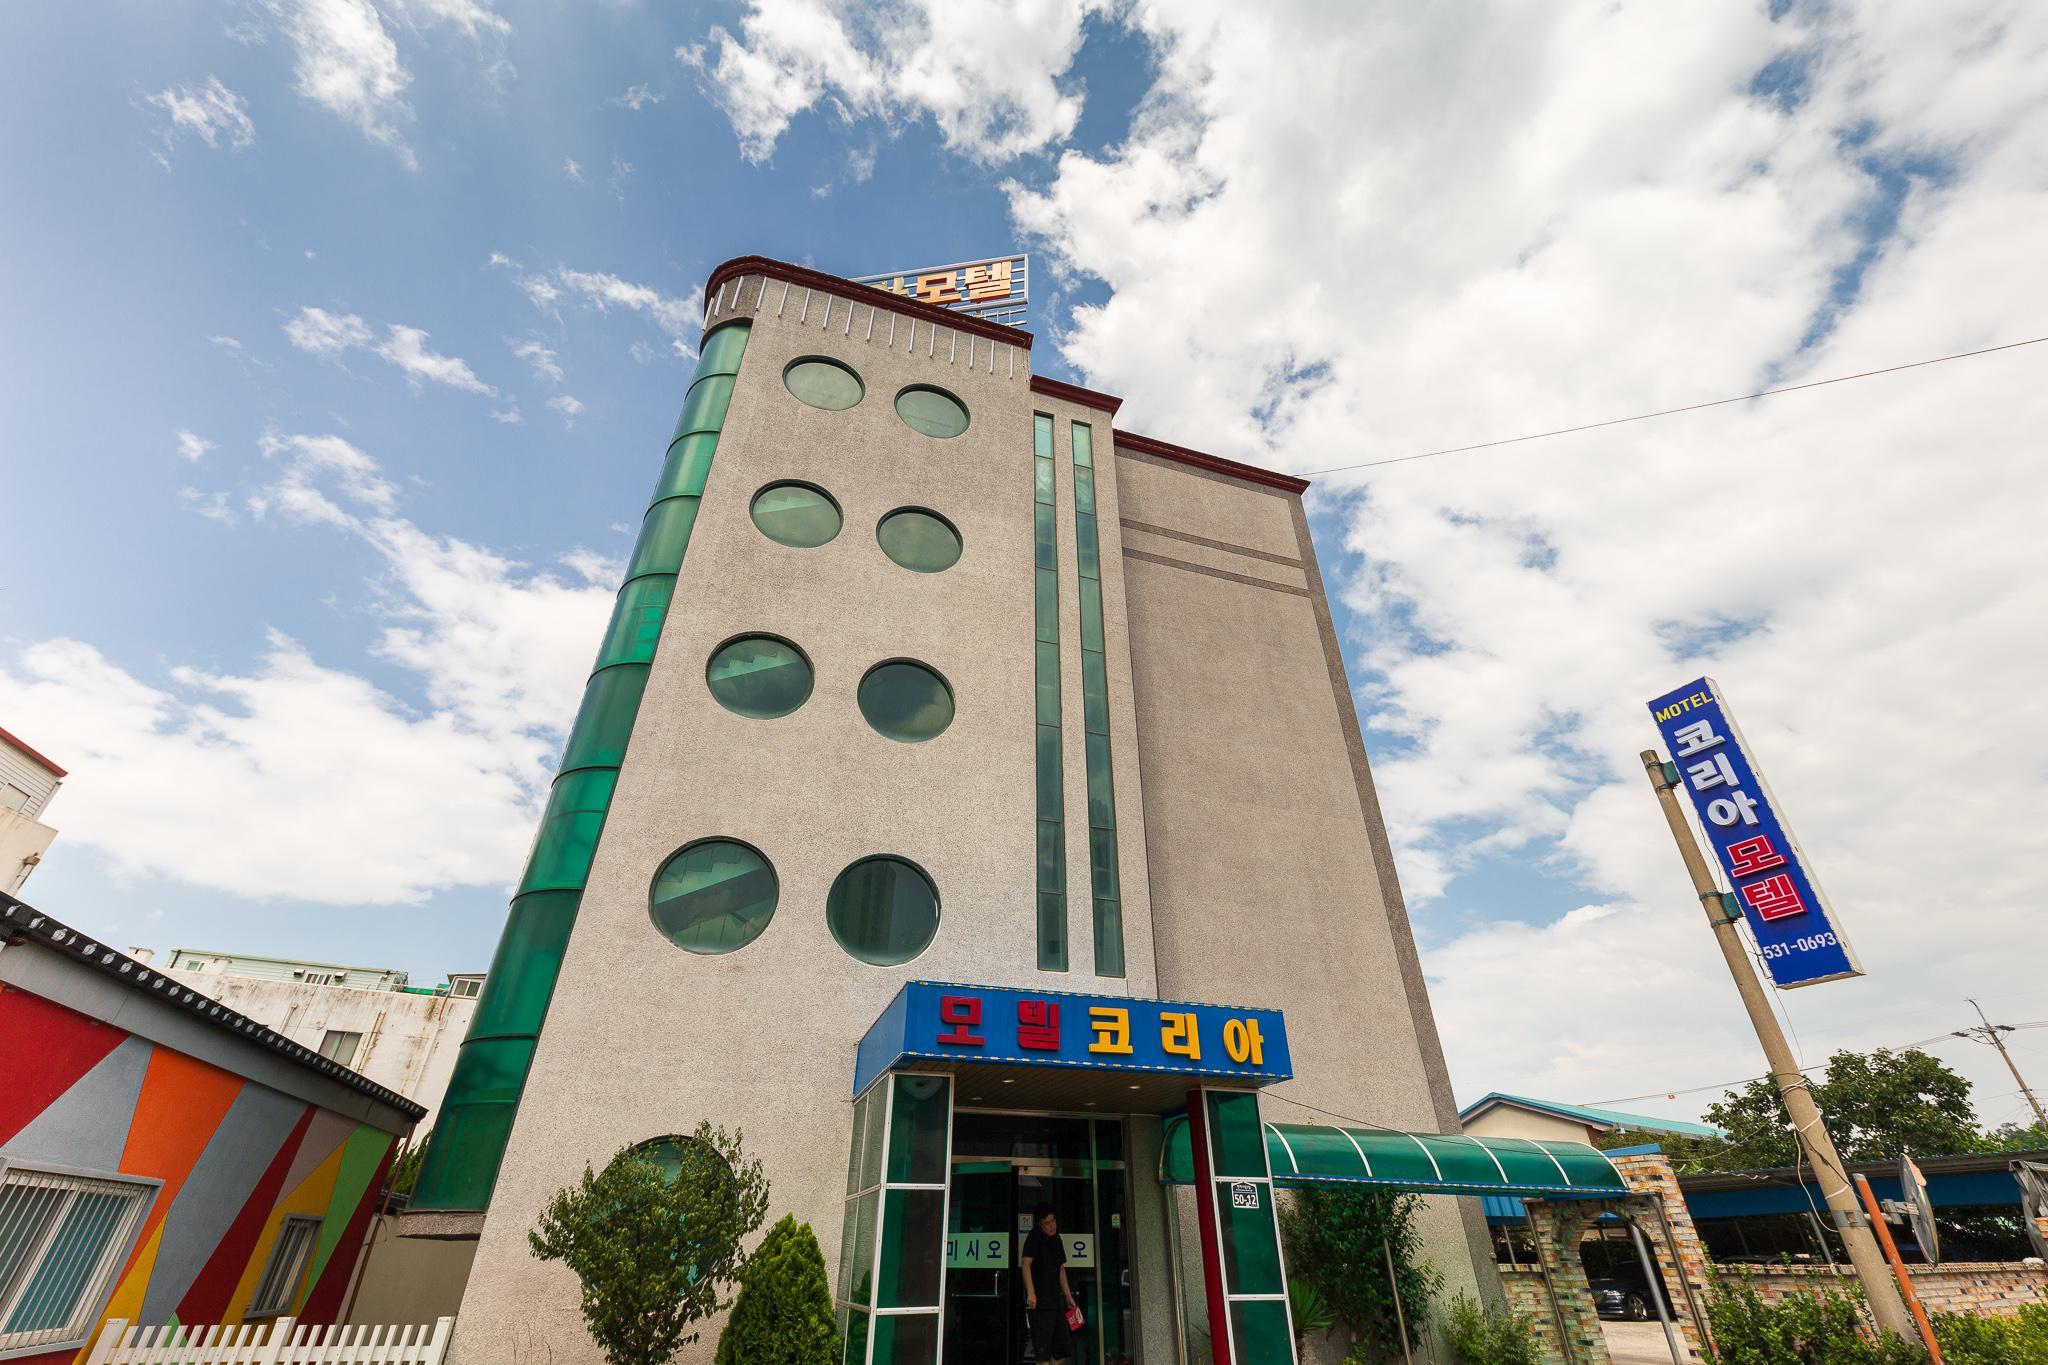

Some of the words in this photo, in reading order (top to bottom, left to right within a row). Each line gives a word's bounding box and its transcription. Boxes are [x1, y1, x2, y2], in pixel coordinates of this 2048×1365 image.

[1655, 691, 1714, 723] MOTEL
[1674, 719, 1760, 827] 코리아
[1726, 834, 1808, 922] 모텔
[1762, 931, 1838, 960] 531-0693
[1089, 1006, 1265, 1065] 코리아
[1234, 1194, 1257, 1206] 50-12
